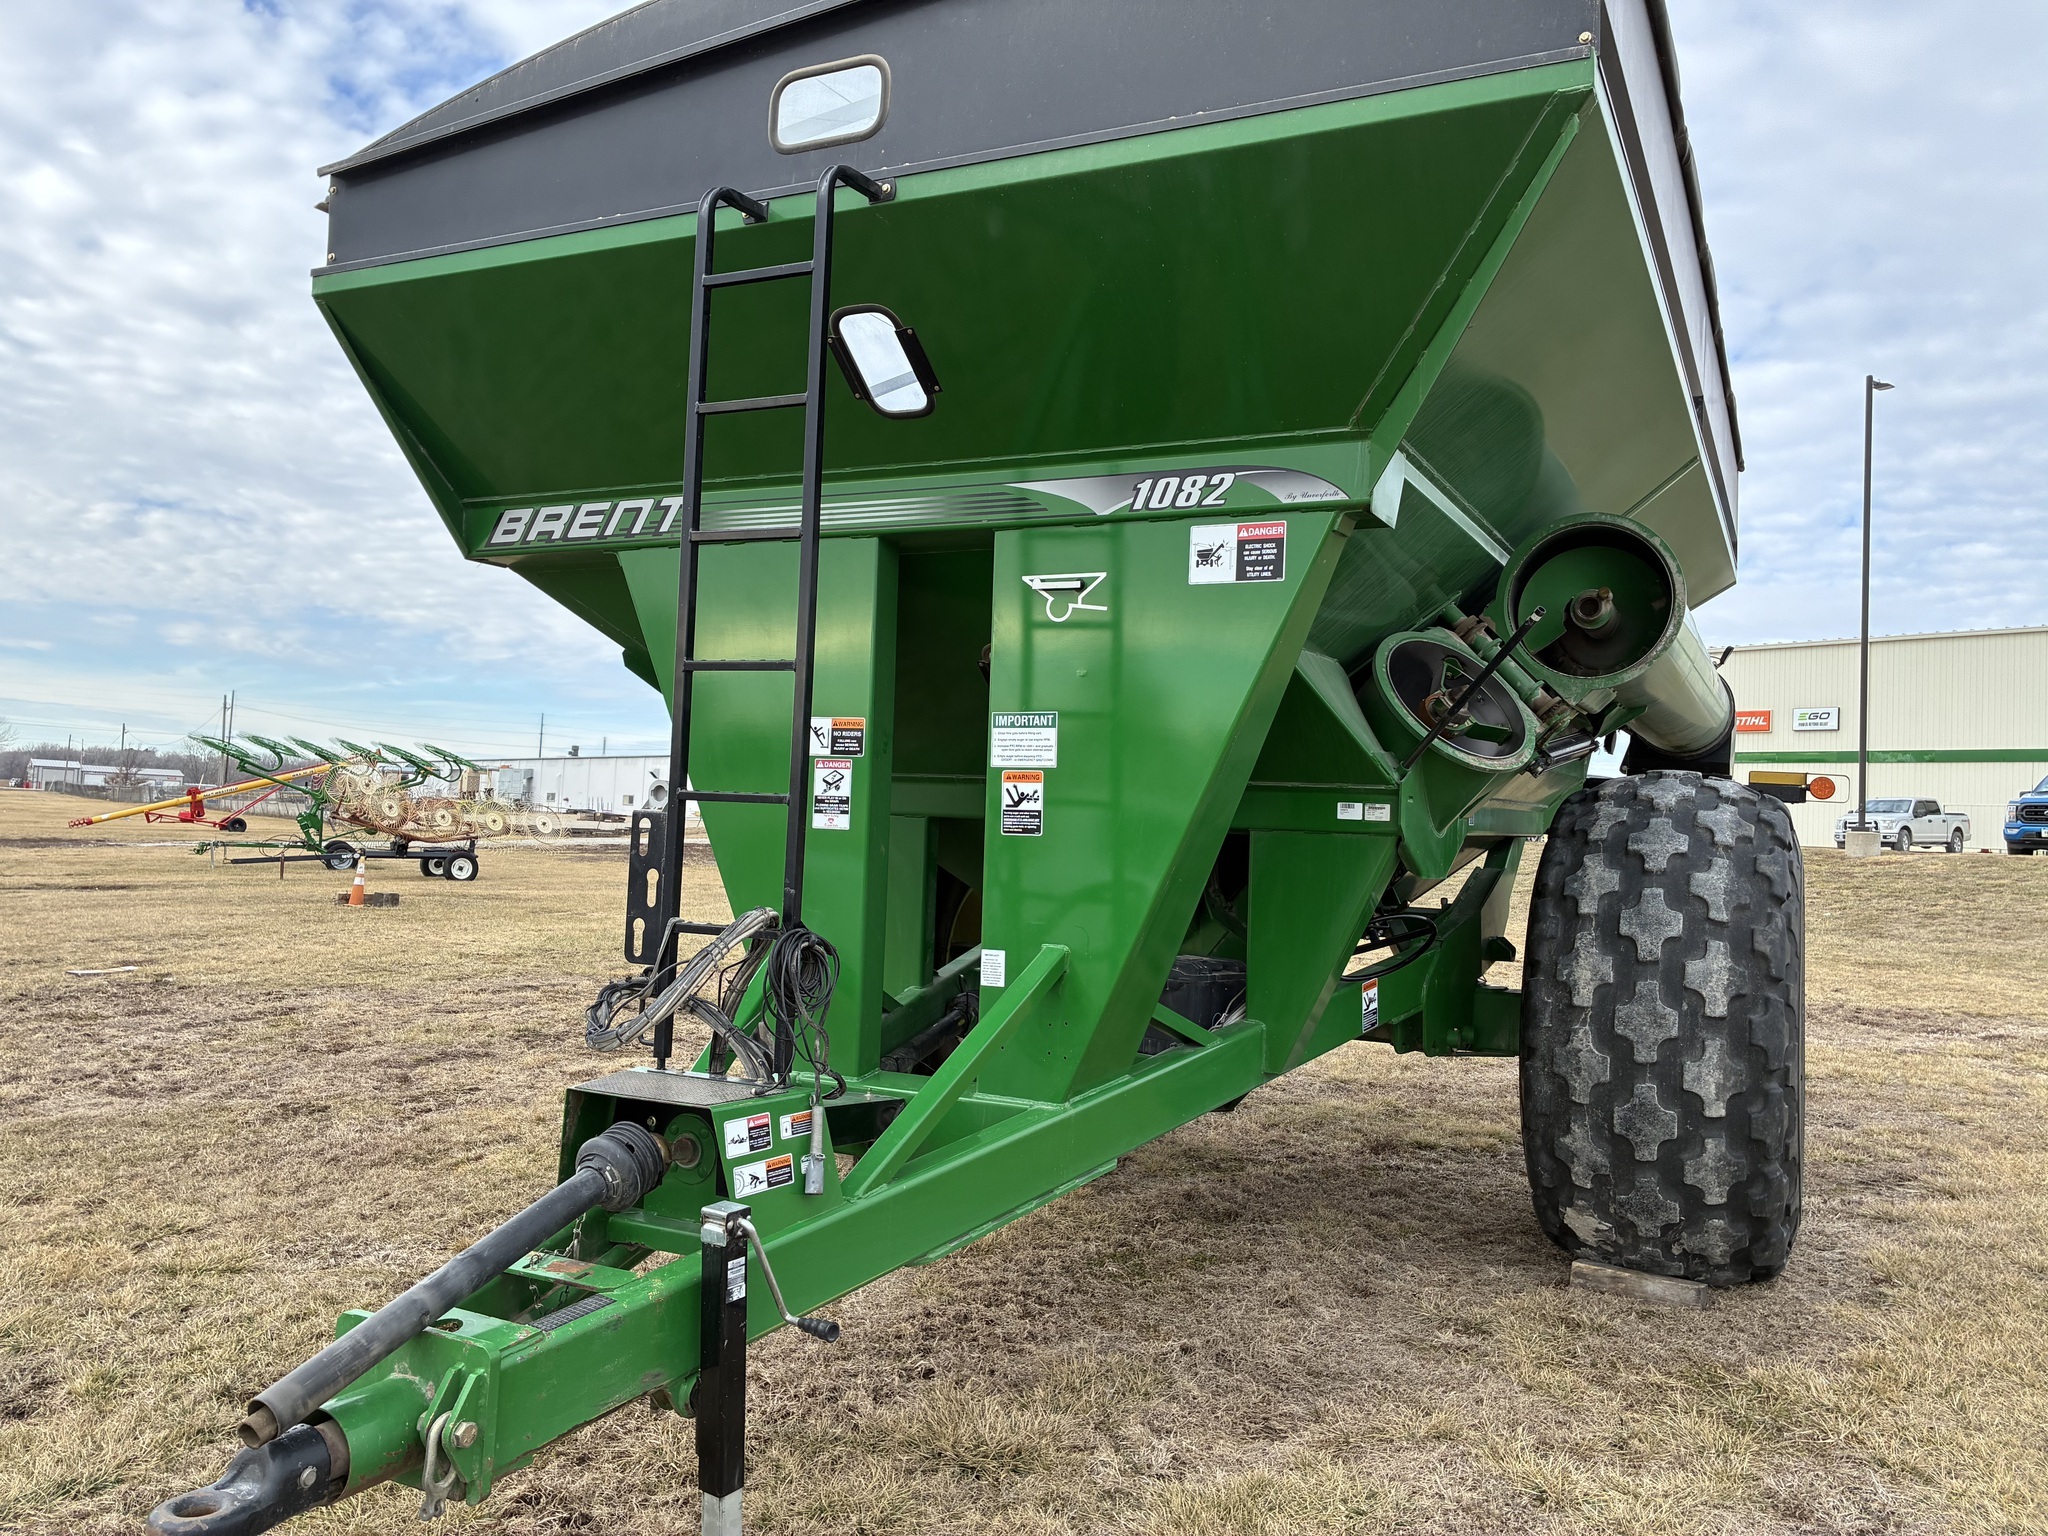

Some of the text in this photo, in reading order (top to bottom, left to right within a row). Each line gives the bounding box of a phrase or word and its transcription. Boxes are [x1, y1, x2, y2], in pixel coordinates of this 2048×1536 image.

[1131, 472, 1236, 511] 1082
[1284, 492, 1298, 501] By
[486, 496, 684, 547] BRENT
[1248, 526, 1284, 536] DANGER
[995, 714, 1054, 727] IMPORTANT
[1798, 712, 1831, 721] EGO
[770, 1157, 791, 1167] WARNING
